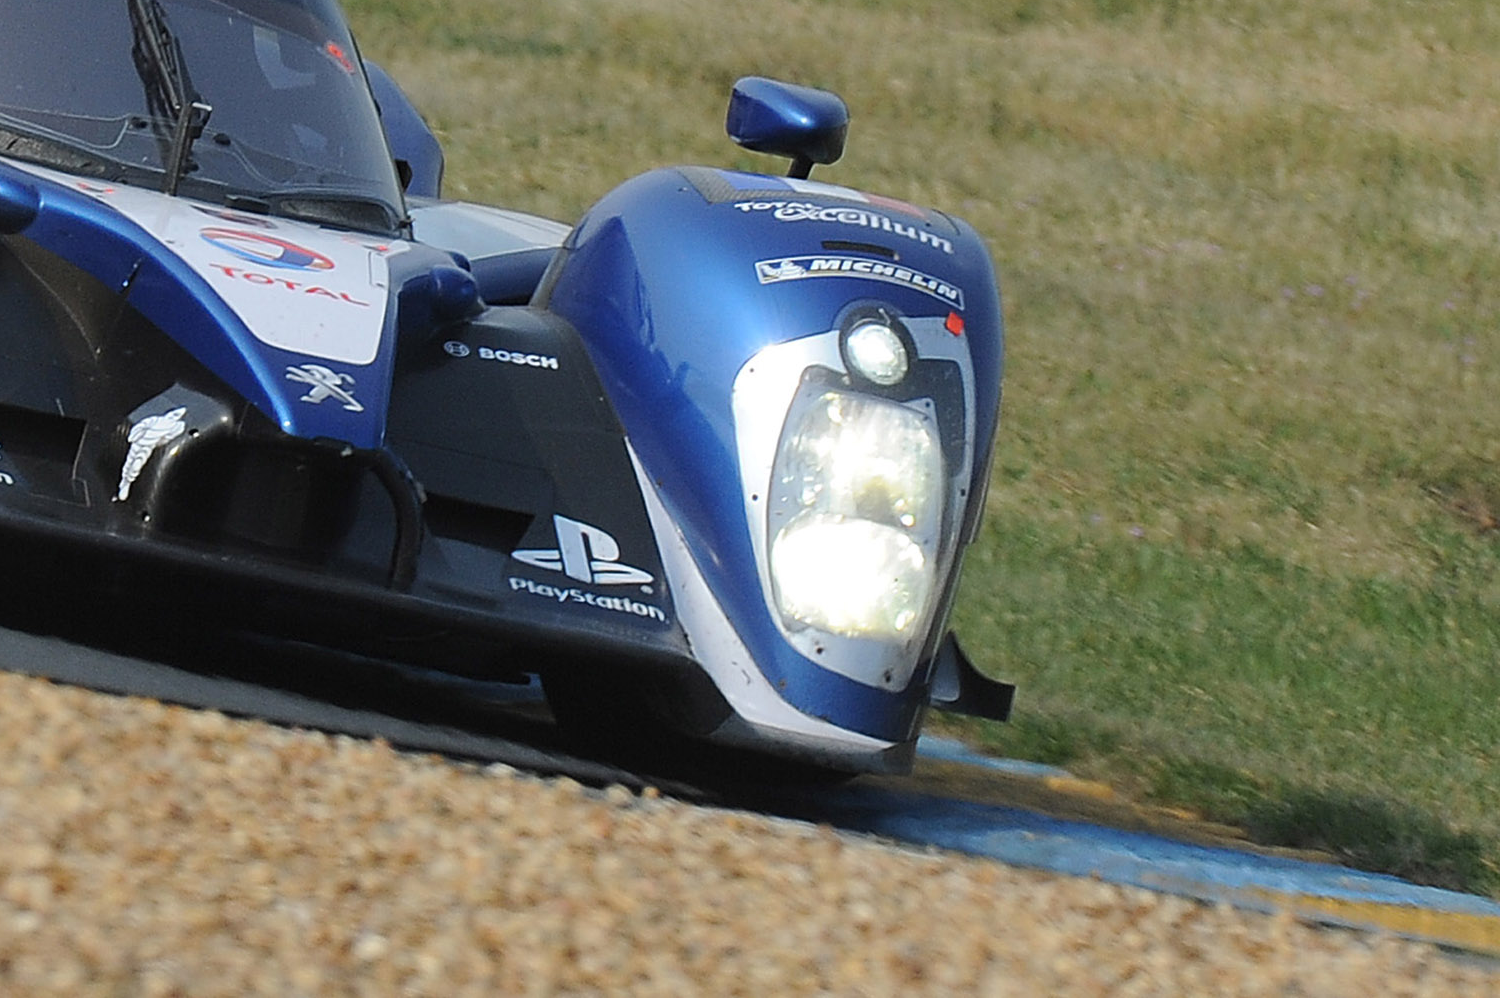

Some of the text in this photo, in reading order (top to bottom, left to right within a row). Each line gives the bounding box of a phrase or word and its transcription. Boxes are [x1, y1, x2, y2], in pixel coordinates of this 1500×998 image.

[208, 263, 371, 307] TOTAL
[809, 258, 959, 301] MICHELIN
[478, 347, 559, 370] BOSCH
[508, 576, 665, 622] PlayStation
